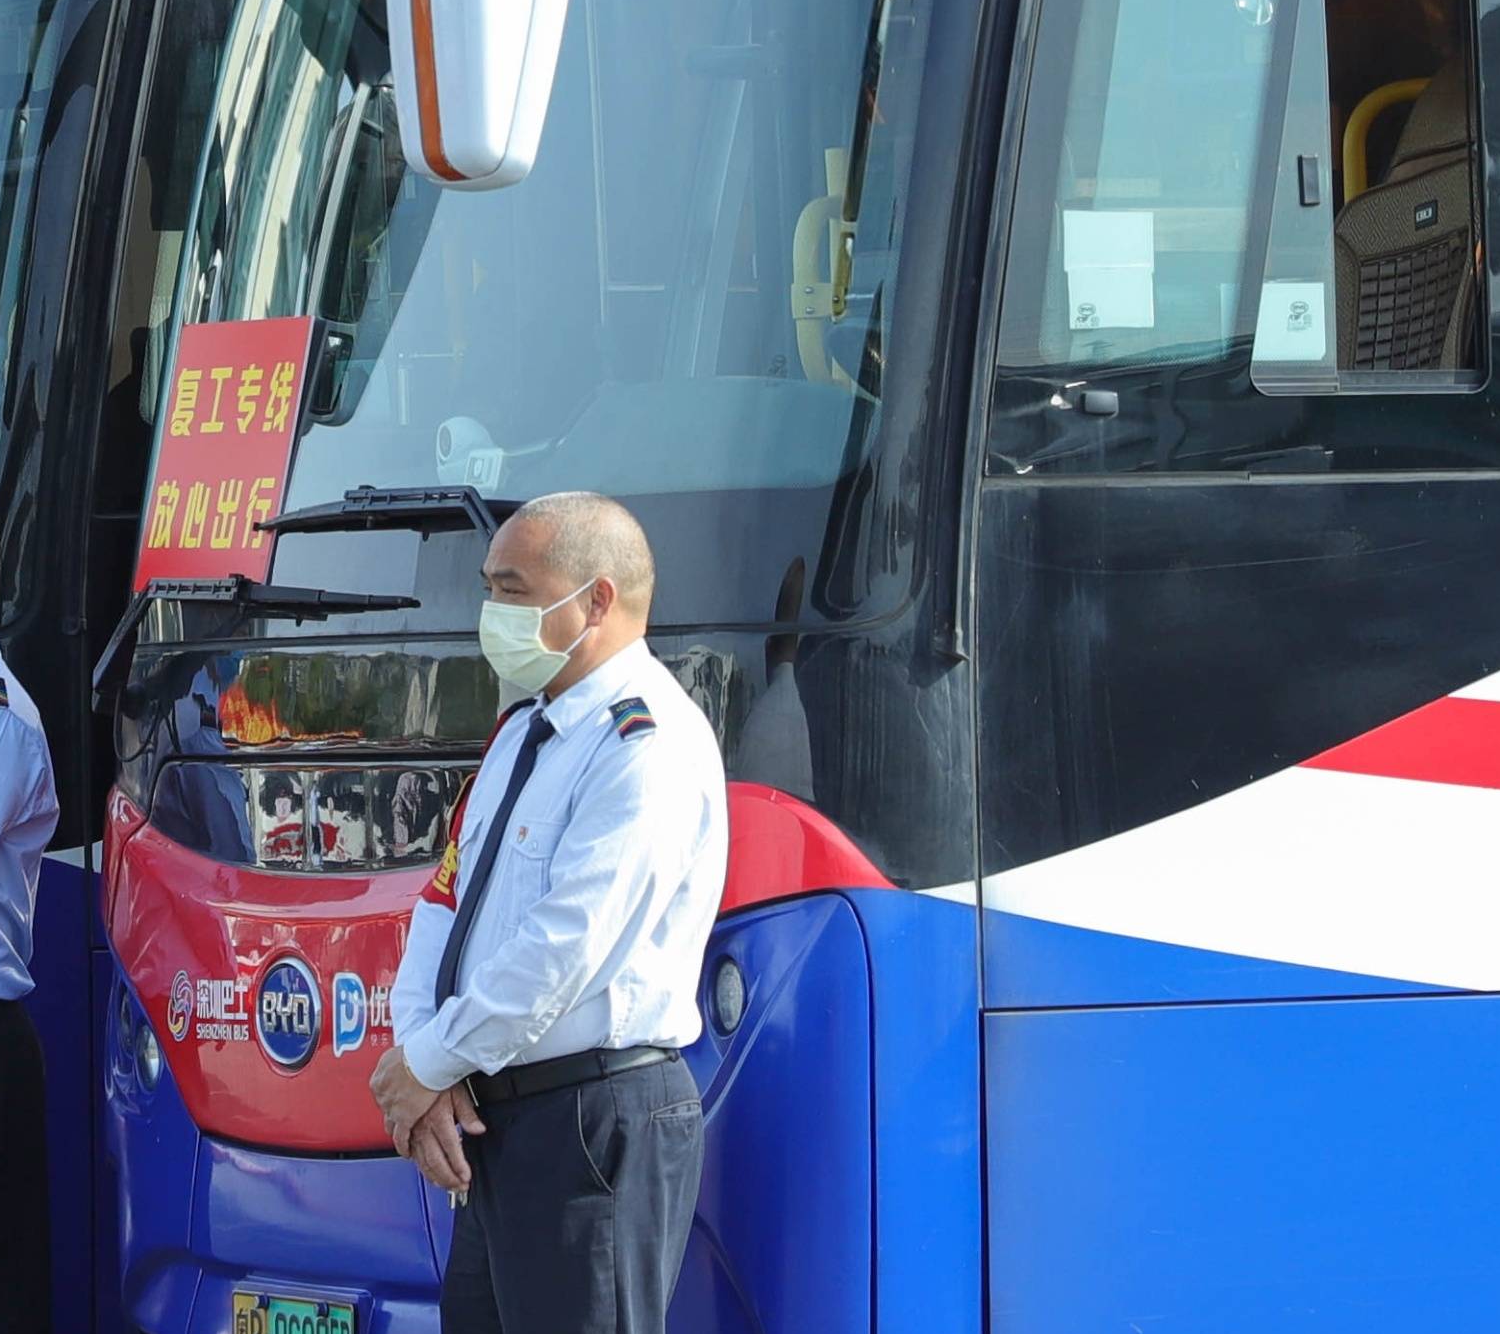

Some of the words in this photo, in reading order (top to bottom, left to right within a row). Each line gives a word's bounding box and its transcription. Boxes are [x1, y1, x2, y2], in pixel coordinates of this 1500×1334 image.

[169, 362, 296, 437] 复工专线
[147, 477, 276, 549] 放心出行
[196, 978, 249, 1021] 深圳巴士
[262, 990, 312, 1035] BYD
